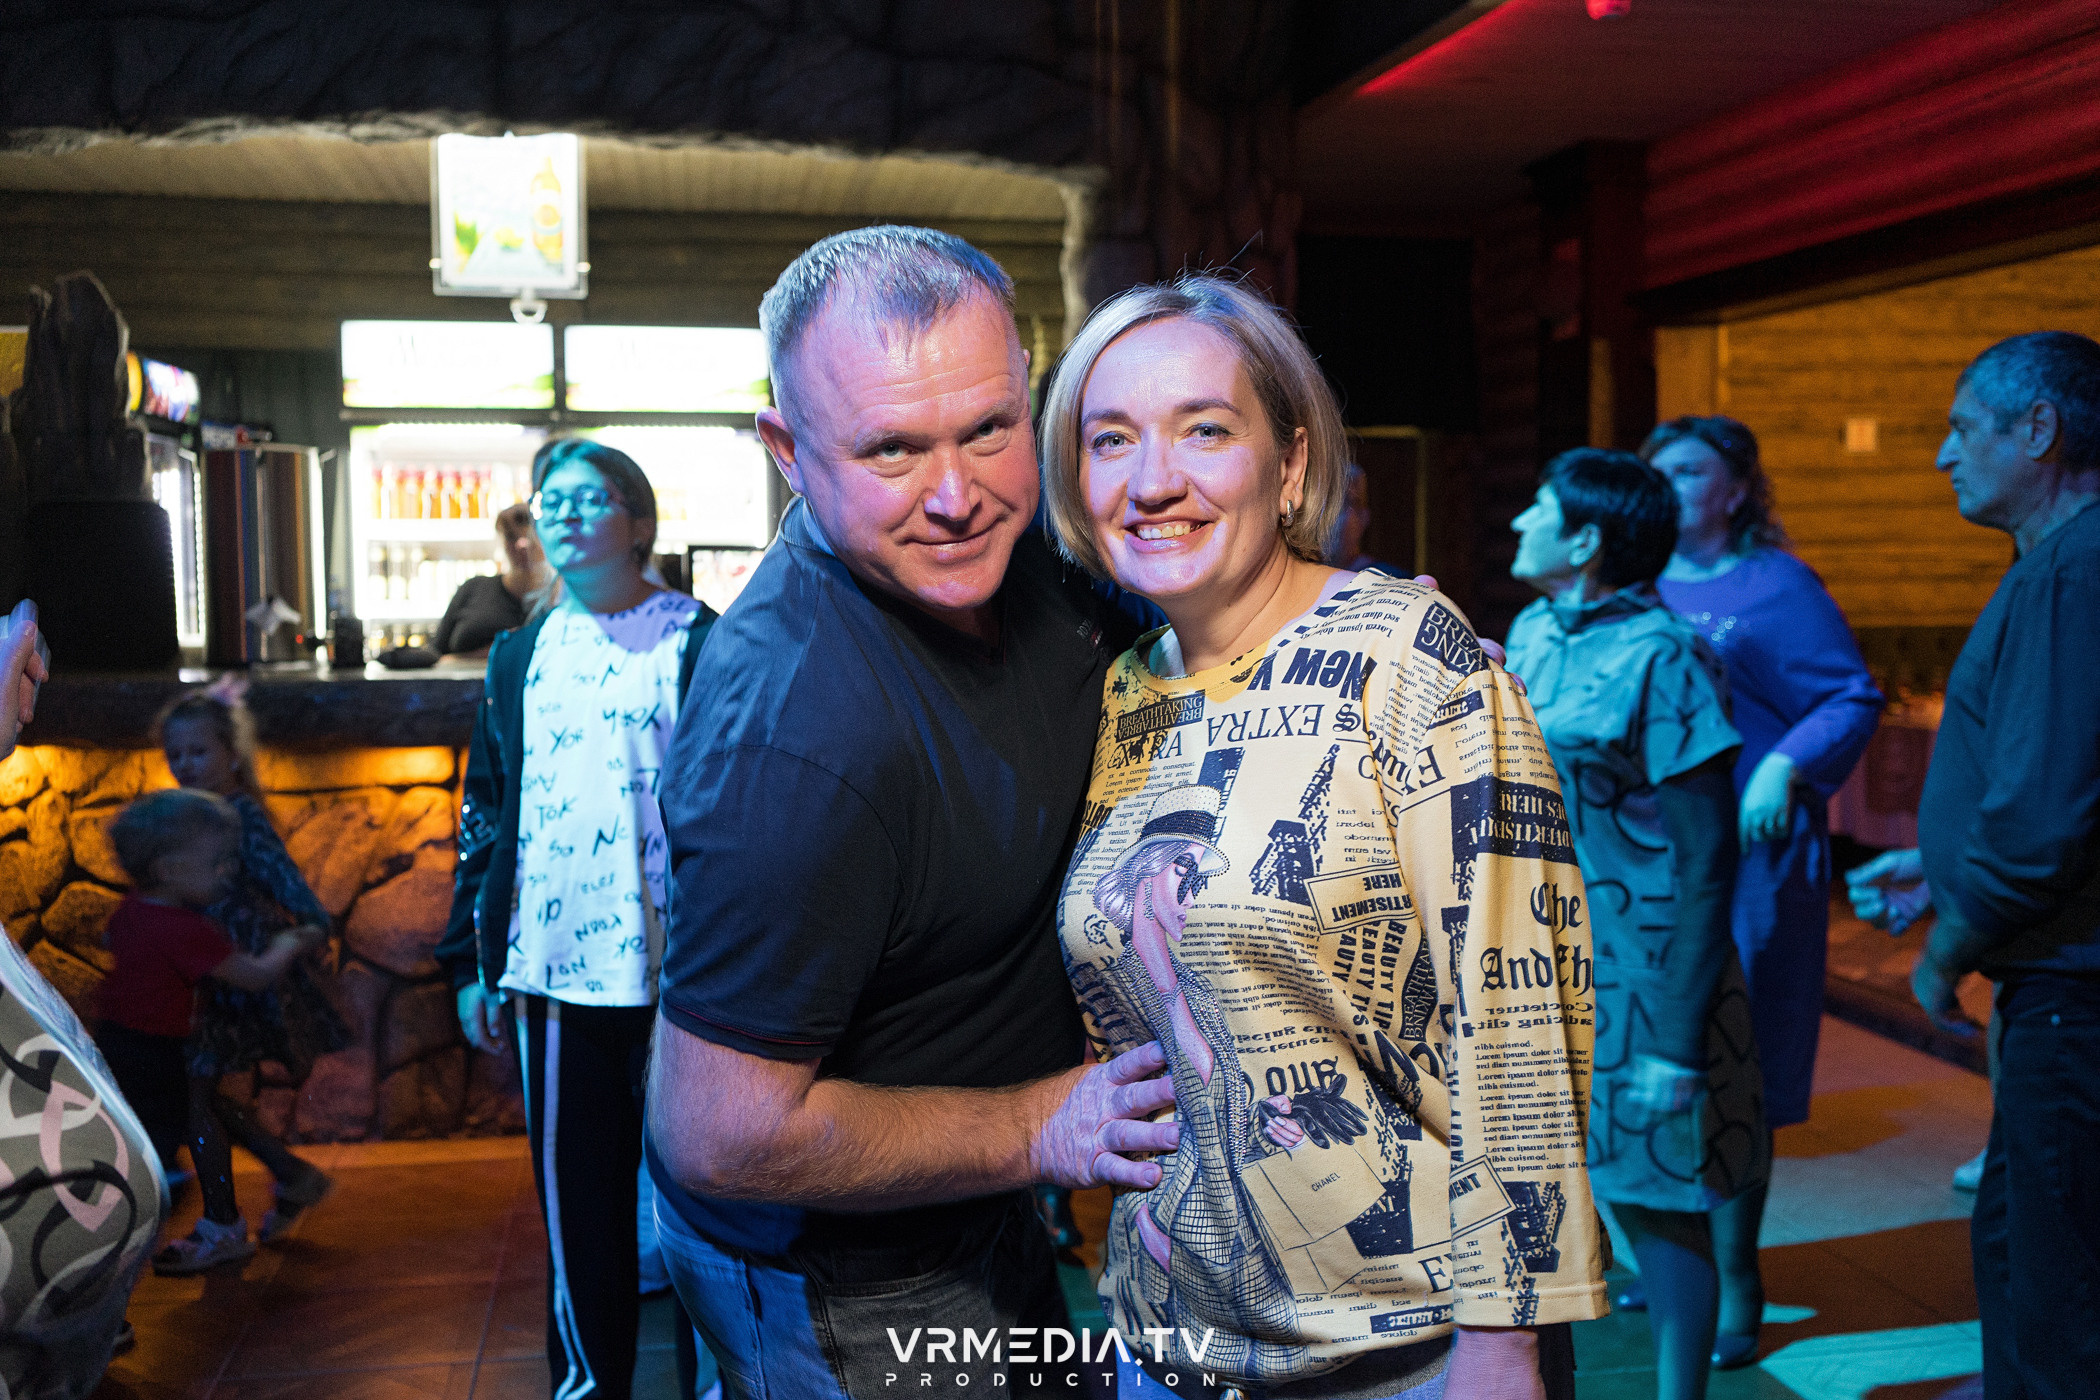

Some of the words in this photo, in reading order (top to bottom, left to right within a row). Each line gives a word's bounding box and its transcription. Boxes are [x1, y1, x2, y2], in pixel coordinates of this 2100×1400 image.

[1376, 598, 1410, 611] Lorem
[1383, 612, 1400, 623] sed
[1365, 623, 1393, 638] Lorem
[1282, 647, 1377, 702] New
[1120, 697, 1203, 728] BREATHTAKING
[1207, 704, 1325, 747] EXTRA
[1363, 873, 1402, 891] HERE
[1332, 894, 1413, 923] RTISEMENT
[1380, 920, 1408, 993] BEAUTY
[1480, 946, 1554, 993] And
[1373, 1001, 1395, 1037] TIP
[1475, 1052, 1501, 1061] Lorem
[1530, 1049, 1551, 1057] dolor
[1553, 1047, 1563, 1055] sit
[1477, 1072, 1506, 1081] Lorem
[1507, 1071, 1535, 1080] ipsum
[1537, 1068, 1558, 1077] dolor
[1478, 1082, 1498, 1091] nibh
[1499, 1080, 1540, 1090] euismod.
[1480, 1094, 1506, 1102] Lorem
[1508, 1093, 1534, 1101] ipsum
[1480, 1103, 1494, 1111] sed
[1496, 1102, 1516, 1110] diam
[1481, 1115, 1511, 1123] Lorem
[1512, 1113, 1542, 1122] ipsum
[1543, 1111, 1565, 1119] dolor
[1512, 1124, 1539, 1132] ipsum
[1541, 1122, 1561, 1130] dolor
[1564, 1120, 1574, 1128] sit
[1484, 1134, 1498, 1142] sed
[1499, 1133, 1520, 1141] diam
[1485, 1146, 1515, 1154] Lorem
[1516, 1144, 1545, 1153] ipsum
[1547, 1142, 1569, 1150] dolor
[1508, 1153, 1549, 1162] euismod.
[1517, 1164, 1544, 1173] ipsum
[1546, 1162, 1566, 1170] dolor
[1568, 1161, 1579, 1169] sit
[1311, 1172, 1341, 1192] CHANEL
[1449, 1172, 1482, 1201] MENT
